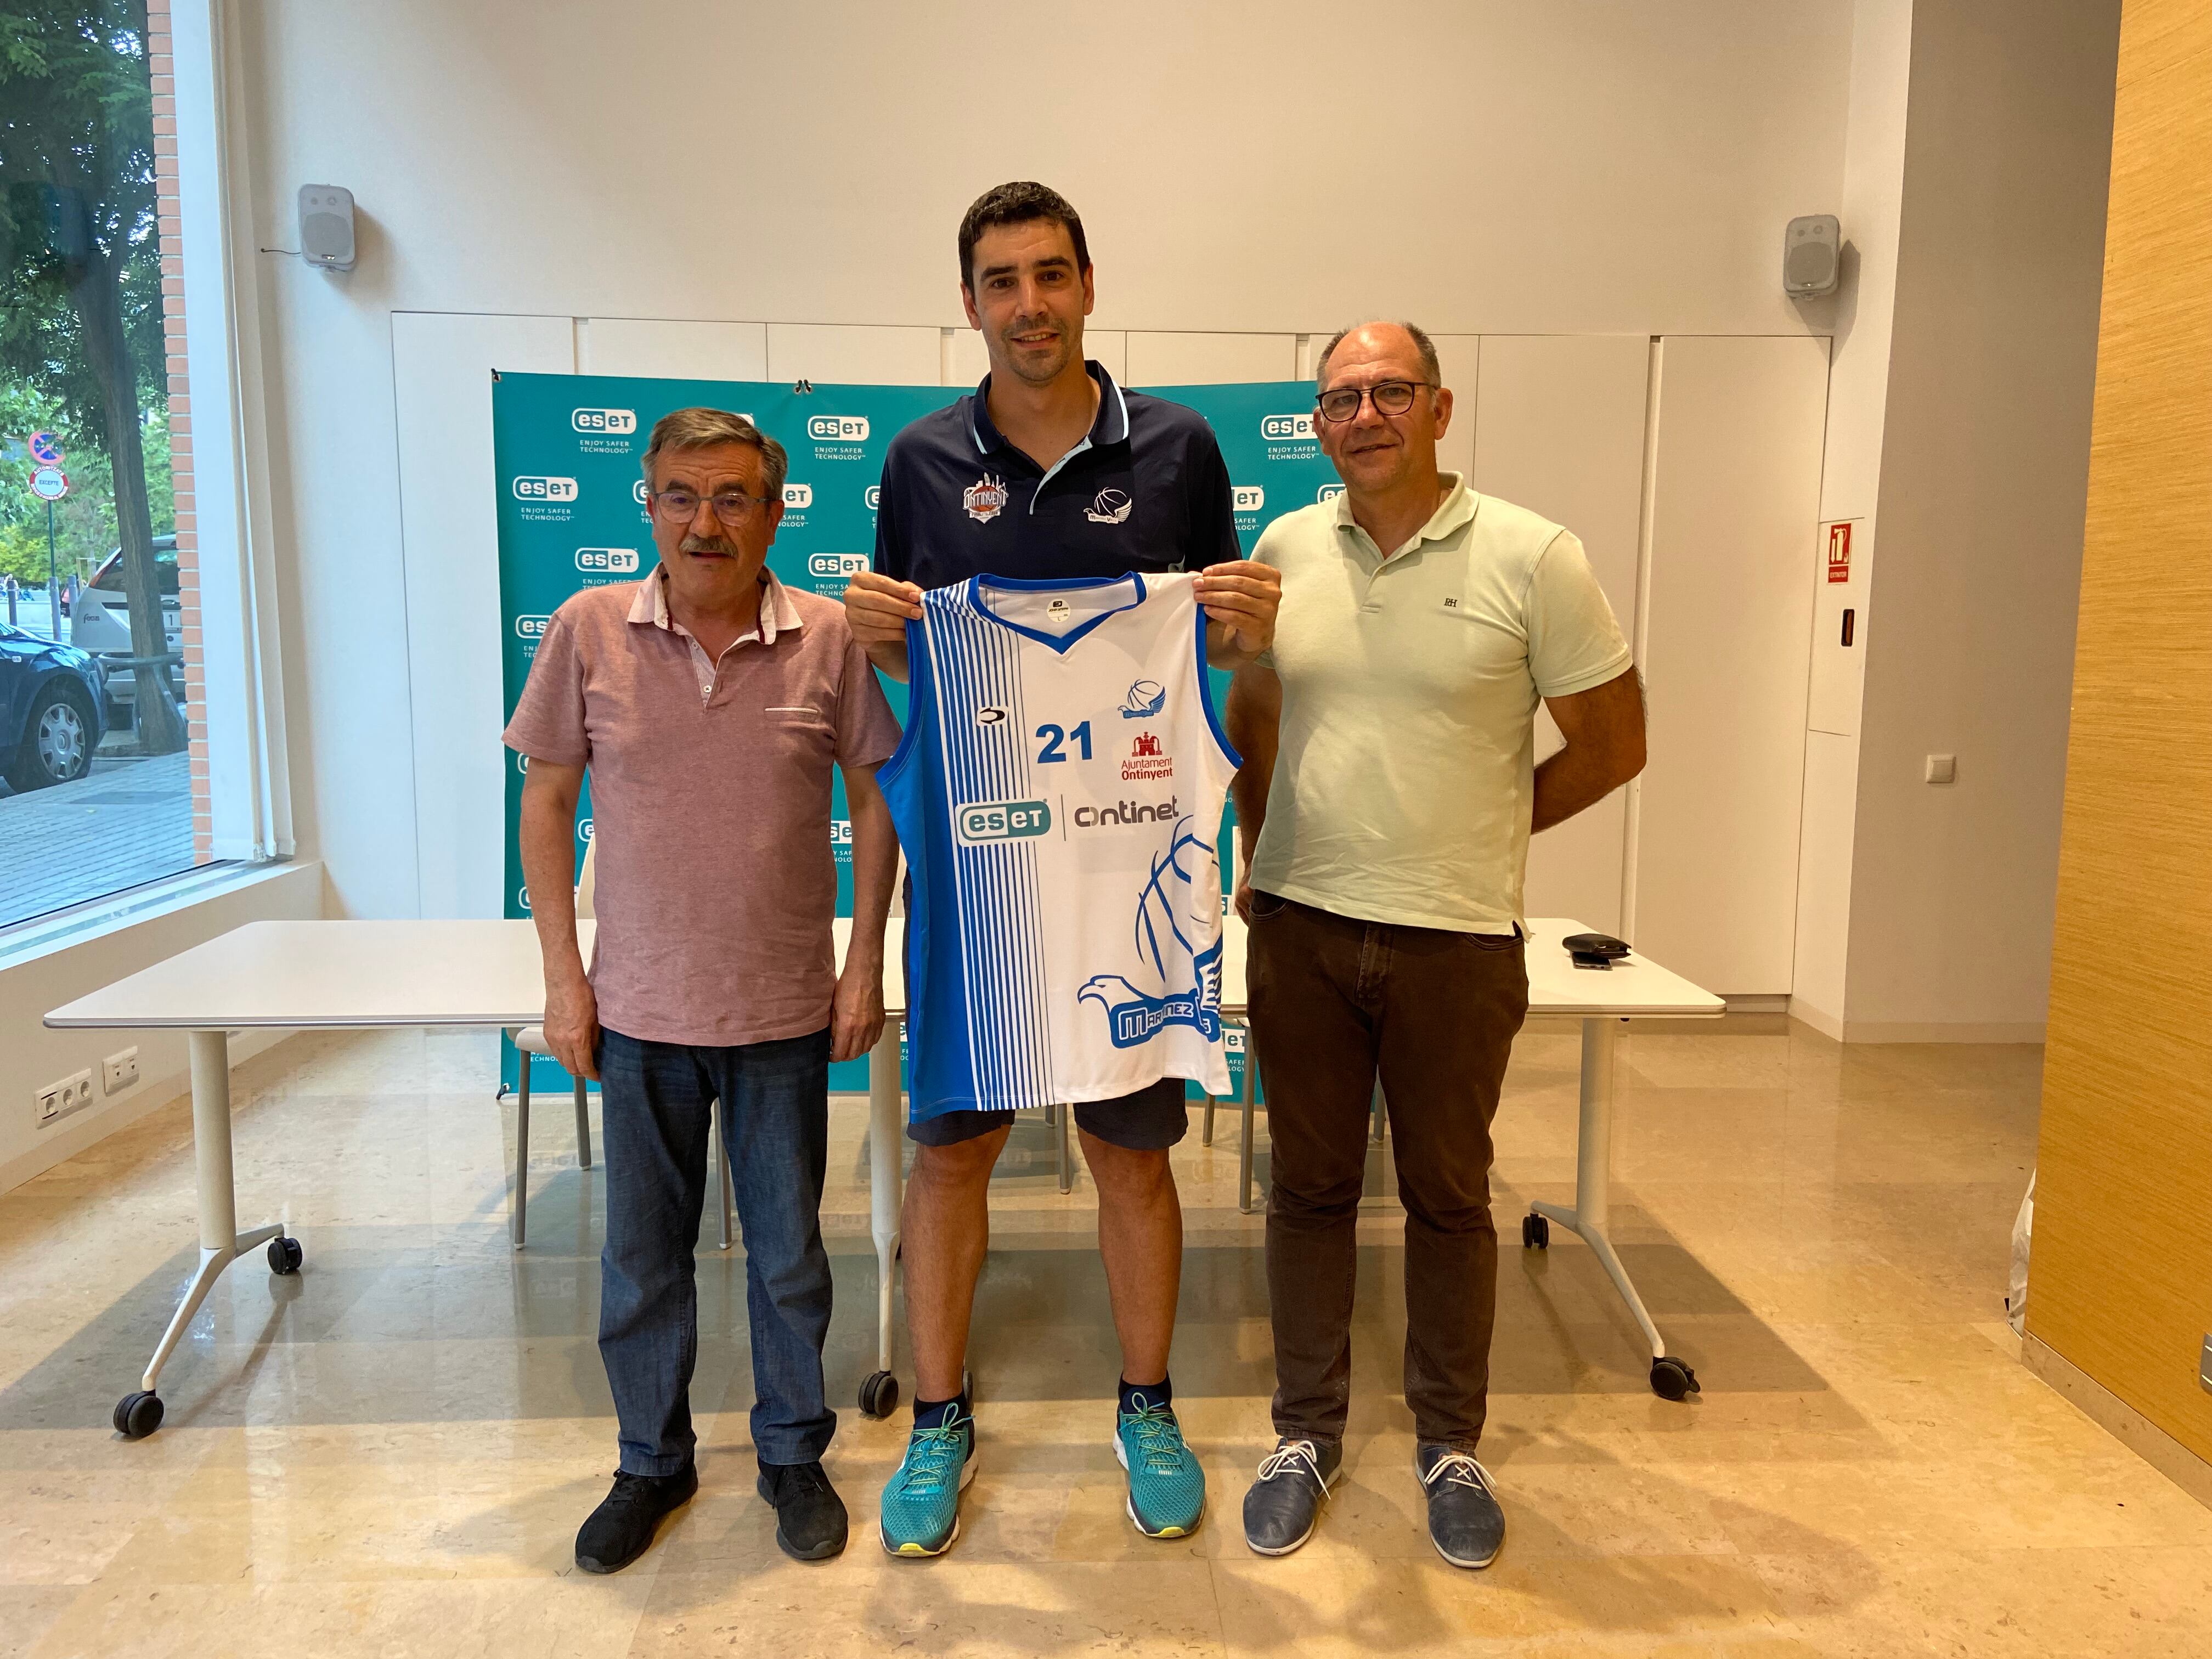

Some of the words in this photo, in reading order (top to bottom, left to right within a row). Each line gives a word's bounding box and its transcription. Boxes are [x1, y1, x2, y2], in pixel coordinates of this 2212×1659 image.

[964, 488, 1008, 509] ONTINYENT
[1035, 721, 1093, 764] 21
[1121, 757, 1172, 772] Ajuntament
[1121, 767, 1173, 781] Ontinyent
